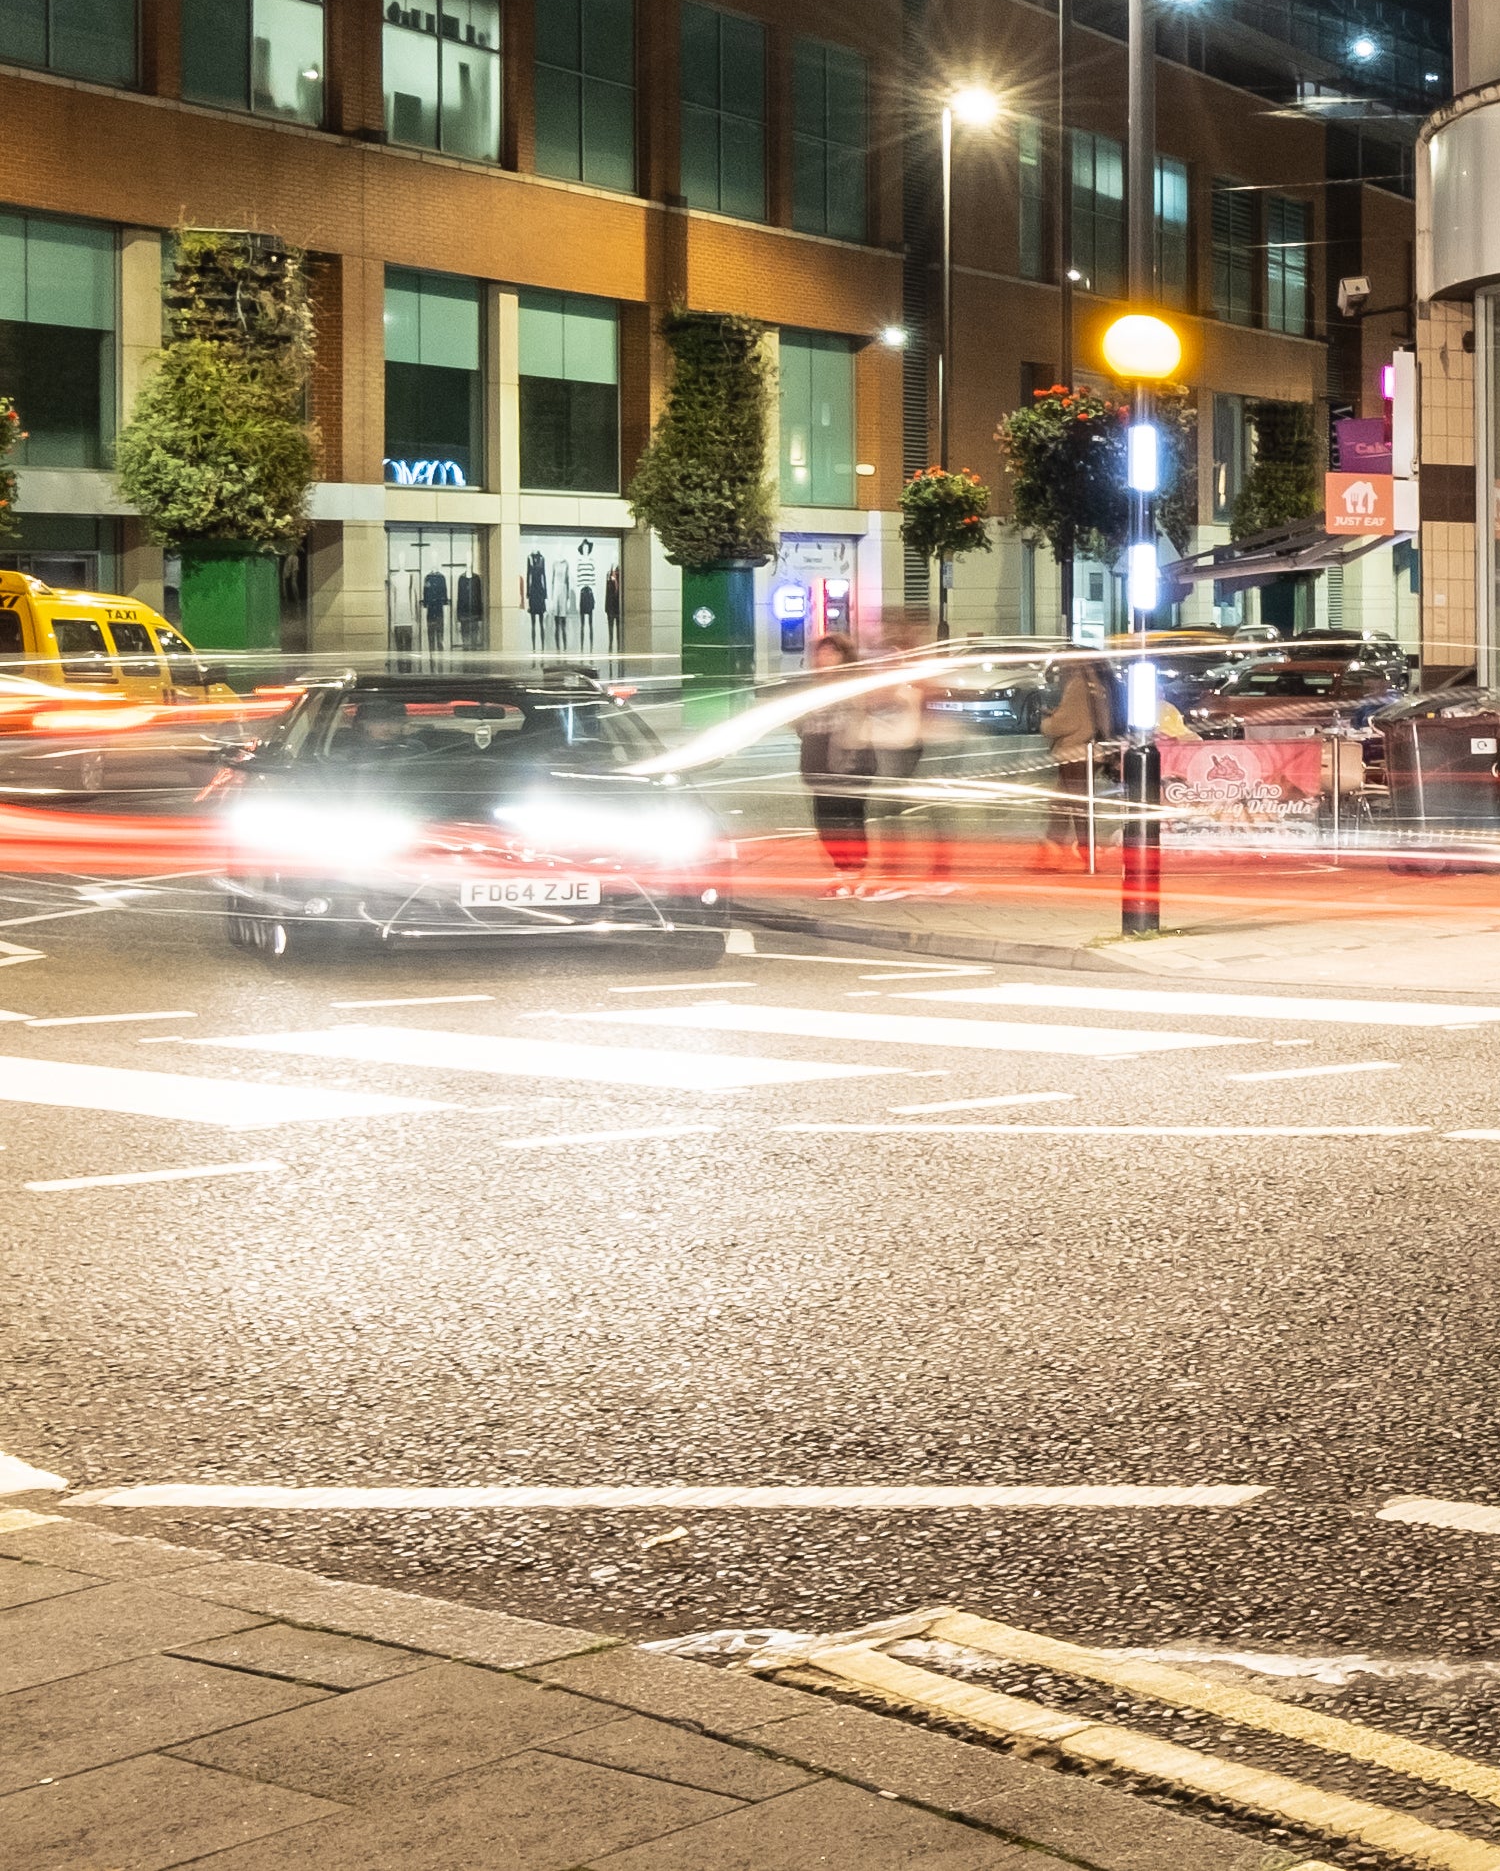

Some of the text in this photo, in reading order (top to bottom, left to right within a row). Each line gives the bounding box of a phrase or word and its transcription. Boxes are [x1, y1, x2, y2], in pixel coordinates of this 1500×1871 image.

[1333, 516, 1387, 527] JUST EAT
[105, 609, 137, 620] TAXI
[1165, 782, 1225, 804] Gelato
[471, 882, 589, 902] FD64 ZJE
